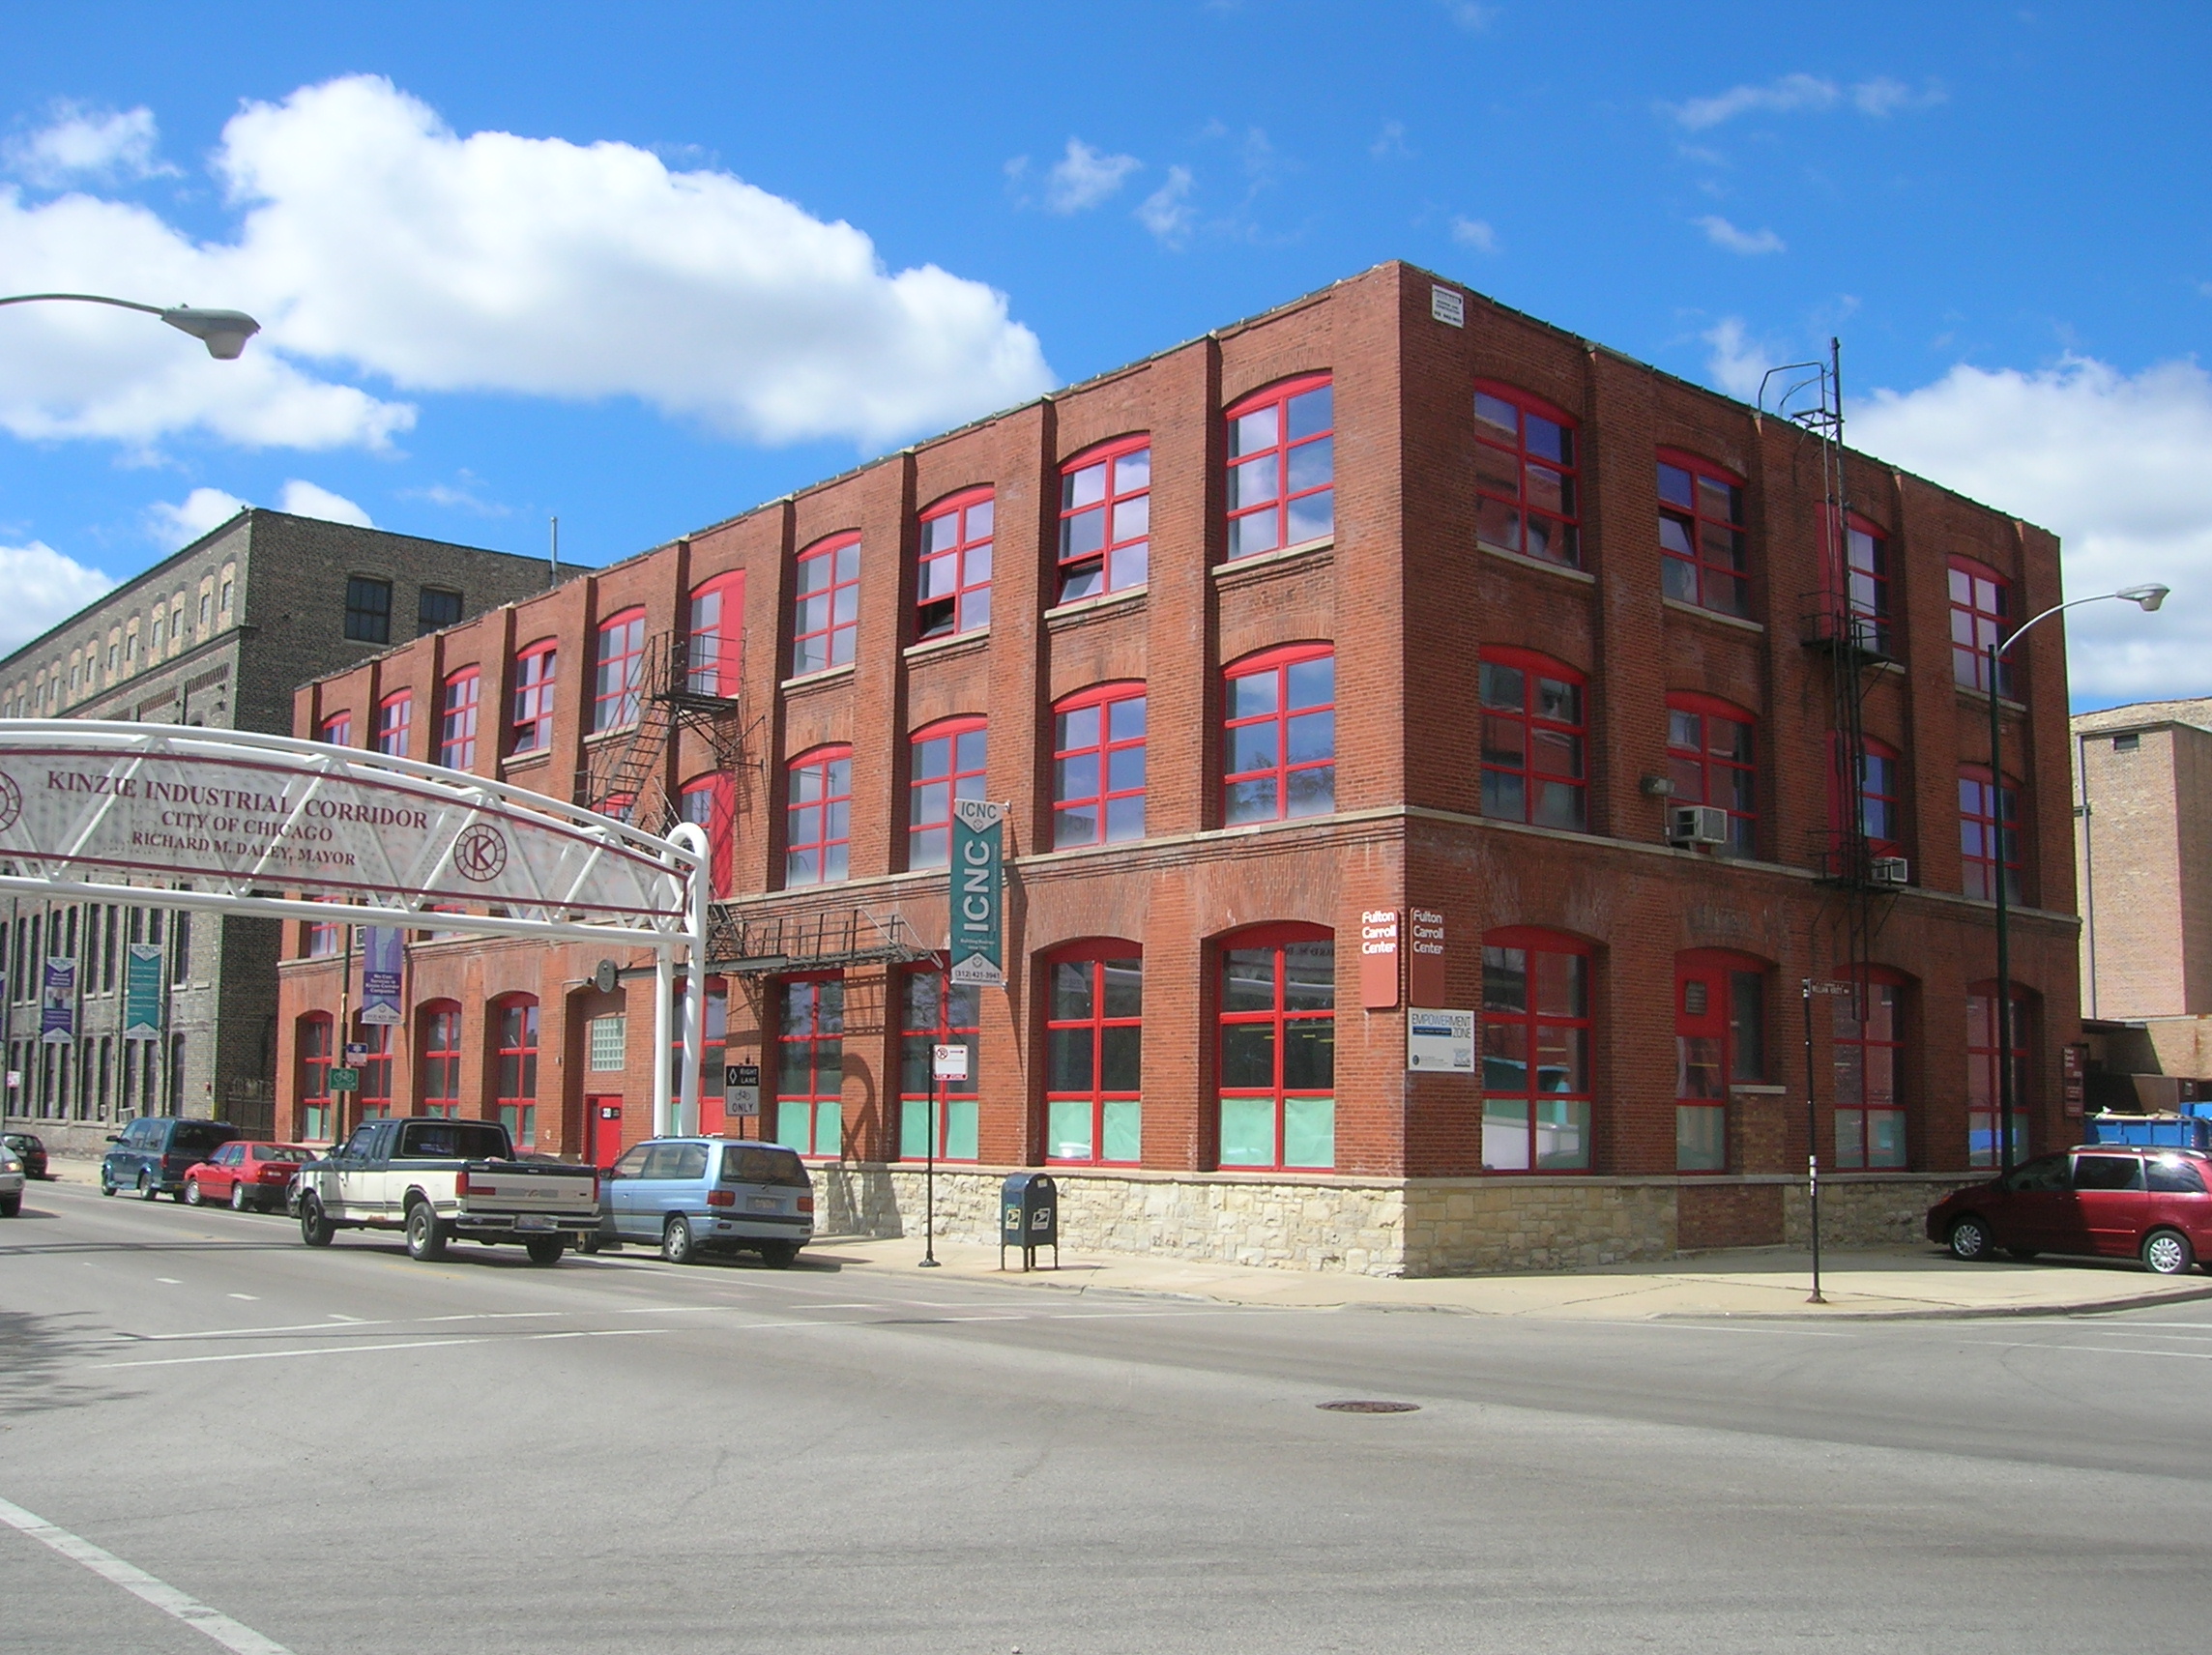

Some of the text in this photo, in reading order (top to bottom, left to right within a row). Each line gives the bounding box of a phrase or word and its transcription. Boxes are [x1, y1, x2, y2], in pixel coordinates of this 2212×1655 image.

[47, 770, 427, 829] KINZIE INDUSTRIAL CORRIDOR
[961, 801, 997, 819] ICNC
[161, 810, 334, 842] CITY OF CHICAGO
[132, 831, 356, 866] RICHARD M. DALEY, MAYOR
[963, 839, 990, 931] ICNC
[1361, 911, 1395, 923] Fulton
[1413, 910, 1442, 923] Fulton
[1361, 924, 1396, 939] Carroll
[1413, 925, 1443, 939] Carroll
[1361, 941, 1396, 954] Center
[1413, 941, 1443, 954] Center
[1412, 1013, 1471, 1027] EMPOWERMENT
[1452, 1027, 1471, 1039] ZONE
[732, 1102, 754, 1113] ONLY
